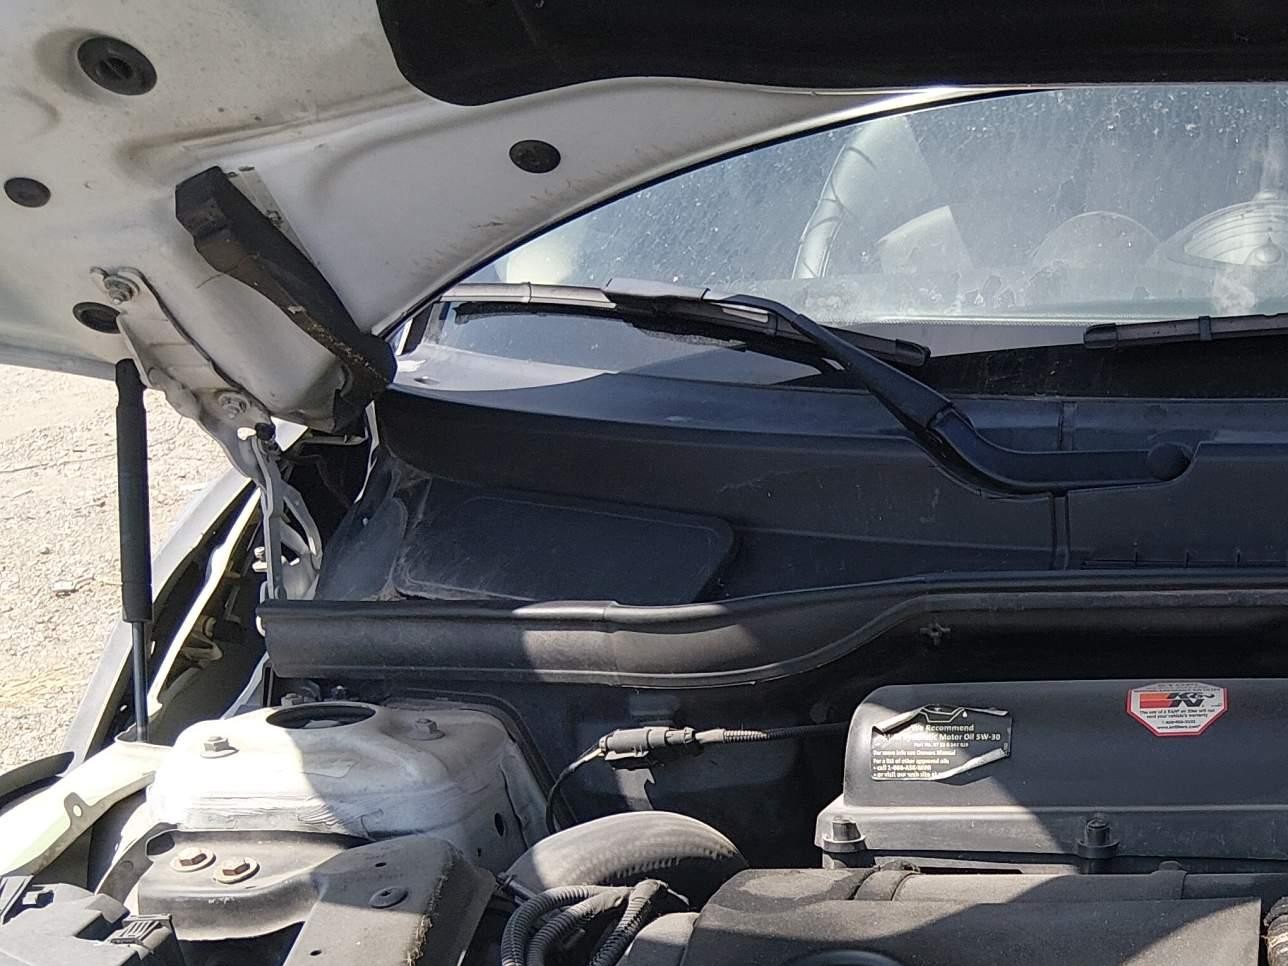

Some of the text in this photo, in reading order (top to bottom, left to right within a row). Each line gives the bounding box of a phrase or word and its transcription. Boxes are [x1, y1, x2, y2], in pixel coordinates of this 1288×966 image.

[926, 724, 974, 732] Recommend
[939, 733, 962, 741] Motor
[964, 733, 975, 741] Oil
[976, 733, 1001, 741] 5W-30
